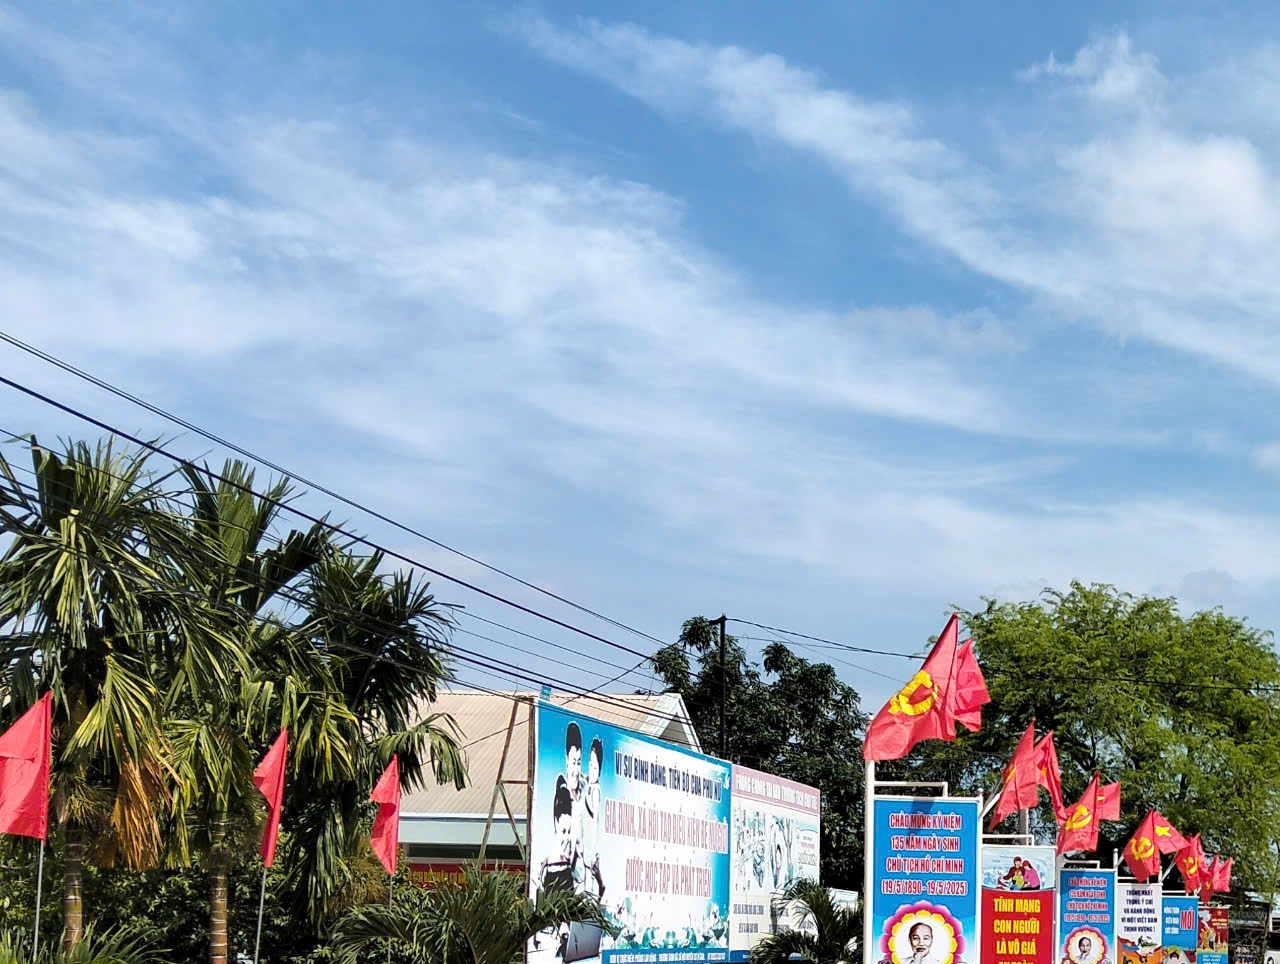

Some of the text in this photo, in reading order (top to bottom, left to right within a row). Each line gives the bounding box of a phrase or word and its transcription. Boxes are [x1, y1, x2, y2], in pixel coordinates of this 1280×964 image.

[890, 810, 962, 832] CHÀO MỪNG KỶ NIỆM
[891, 833, 960, 852] 135 NĂM NGÀY SINH
[886, 854, 964, 875] CHỦ TỊCH HỒ CHÍ MINH
[994, 896, 1041, 916] TÍNH MẠNG
[994, 917, 1040, 934] CON NGƯỜI
[1180, 905, 1195, 930] MỚI
[996, 937, 1036, 955] LÀ VÔ GIÁ
